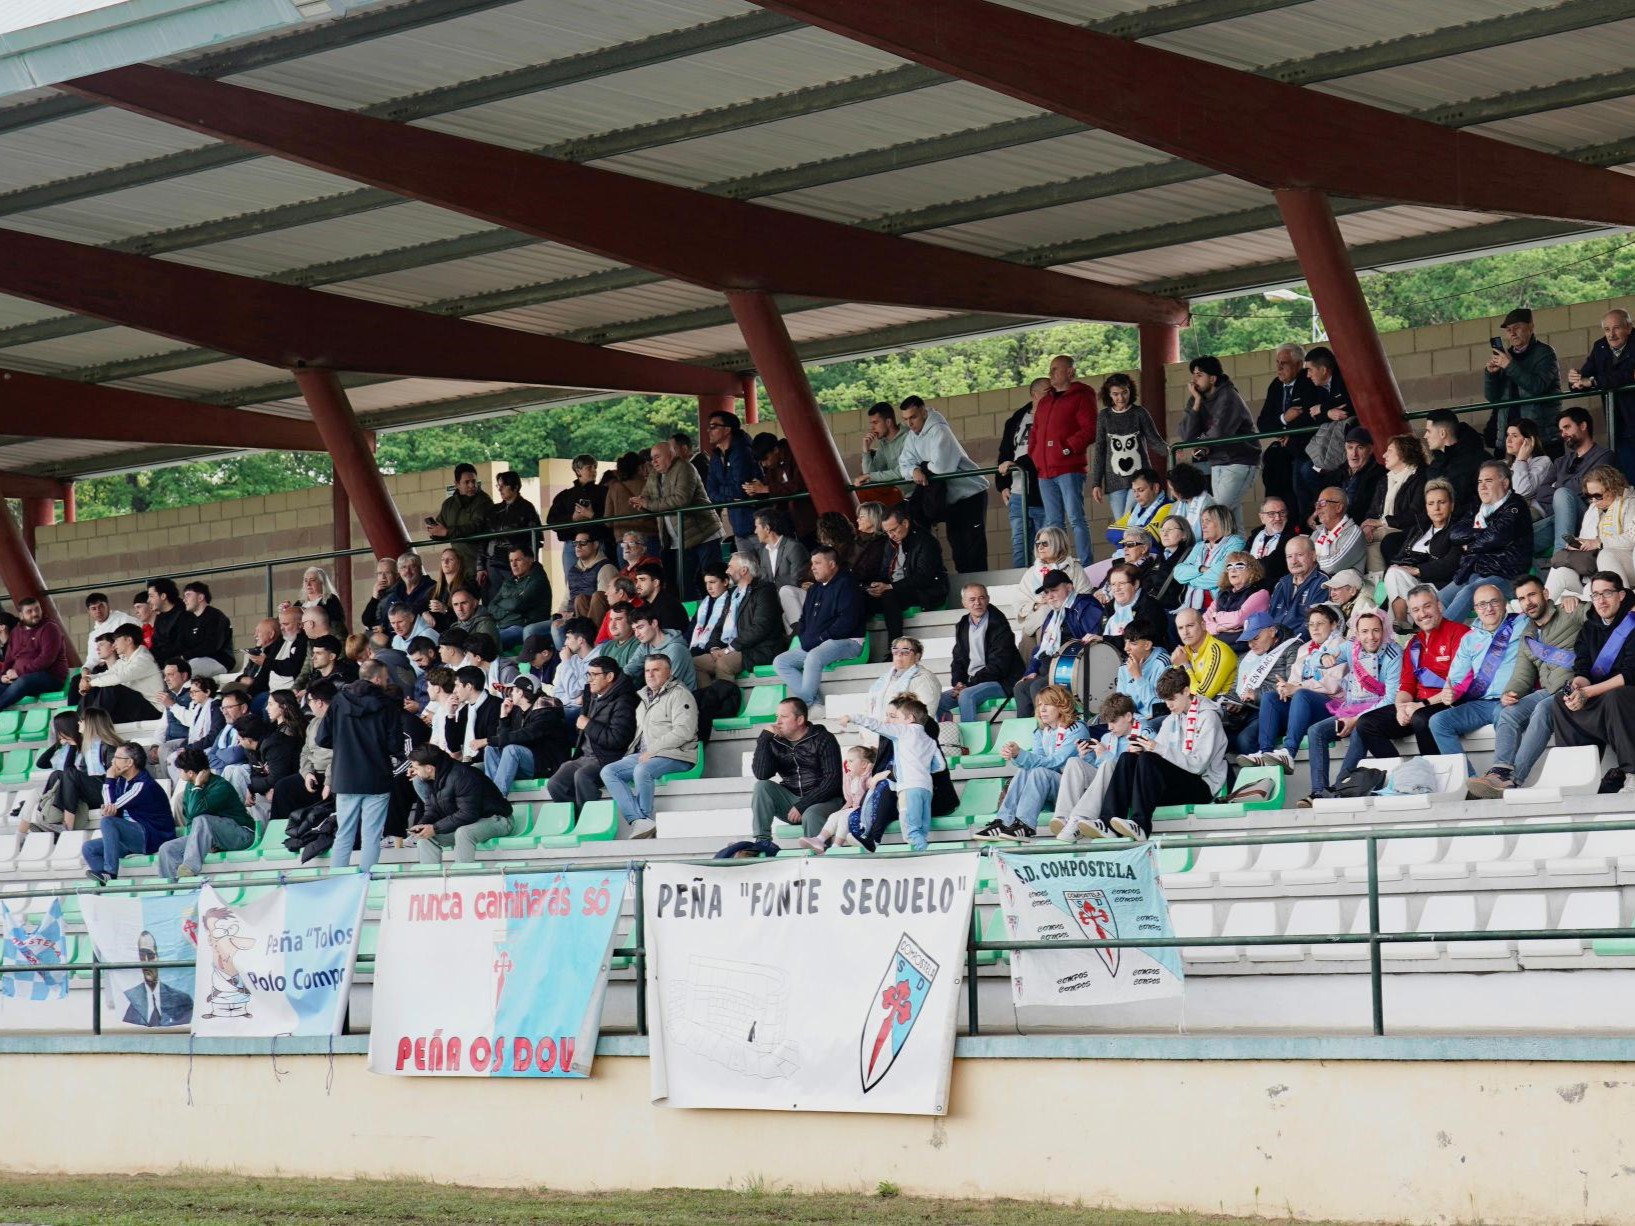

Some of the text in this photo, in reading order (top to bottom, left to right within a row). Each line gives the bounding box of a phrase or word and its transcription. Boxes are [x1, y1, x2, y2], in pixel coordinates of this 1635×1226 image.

[1249, 673, 1260, 684] EN
[1040, 860, 1137, 880] COMPOSTELA
[408, 891, 463, 921] nunca
[582, 876, 611, 917] só
[657, 875, 967, 919] PEÑA "FONTE SEQUELO"
[266, 930, 303, 955] Peña
[248, 970, 287, 992] Polo
[897, 960, 924, 991] S D
[395, 1028, 462, 1071] PEÑA
[469, 1036, 505, 1072] OS
